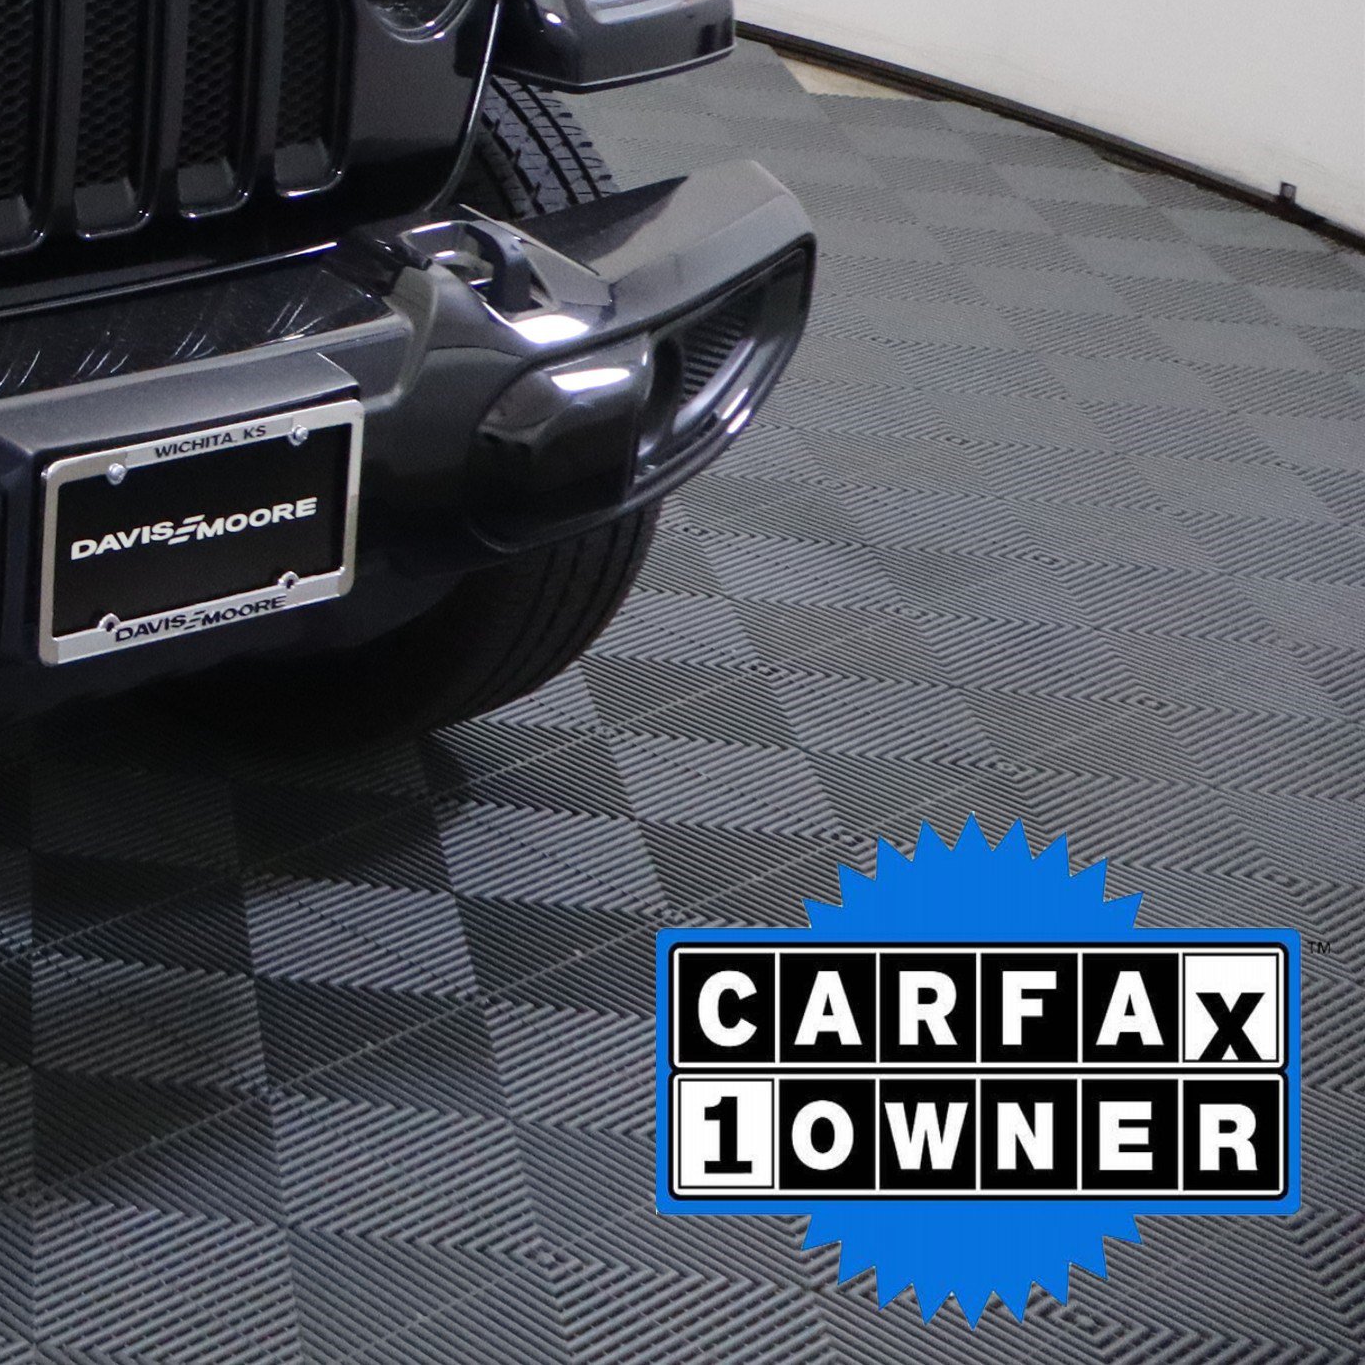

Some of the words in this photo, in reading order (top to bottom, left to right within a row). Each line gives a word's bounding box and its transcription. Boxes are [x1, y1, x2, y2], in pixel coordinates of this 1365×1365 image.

[243, 425, 267, 440] KS
[71, 521, 174, 561] DAVIS
[196, 497, 318, 541] MOORE
